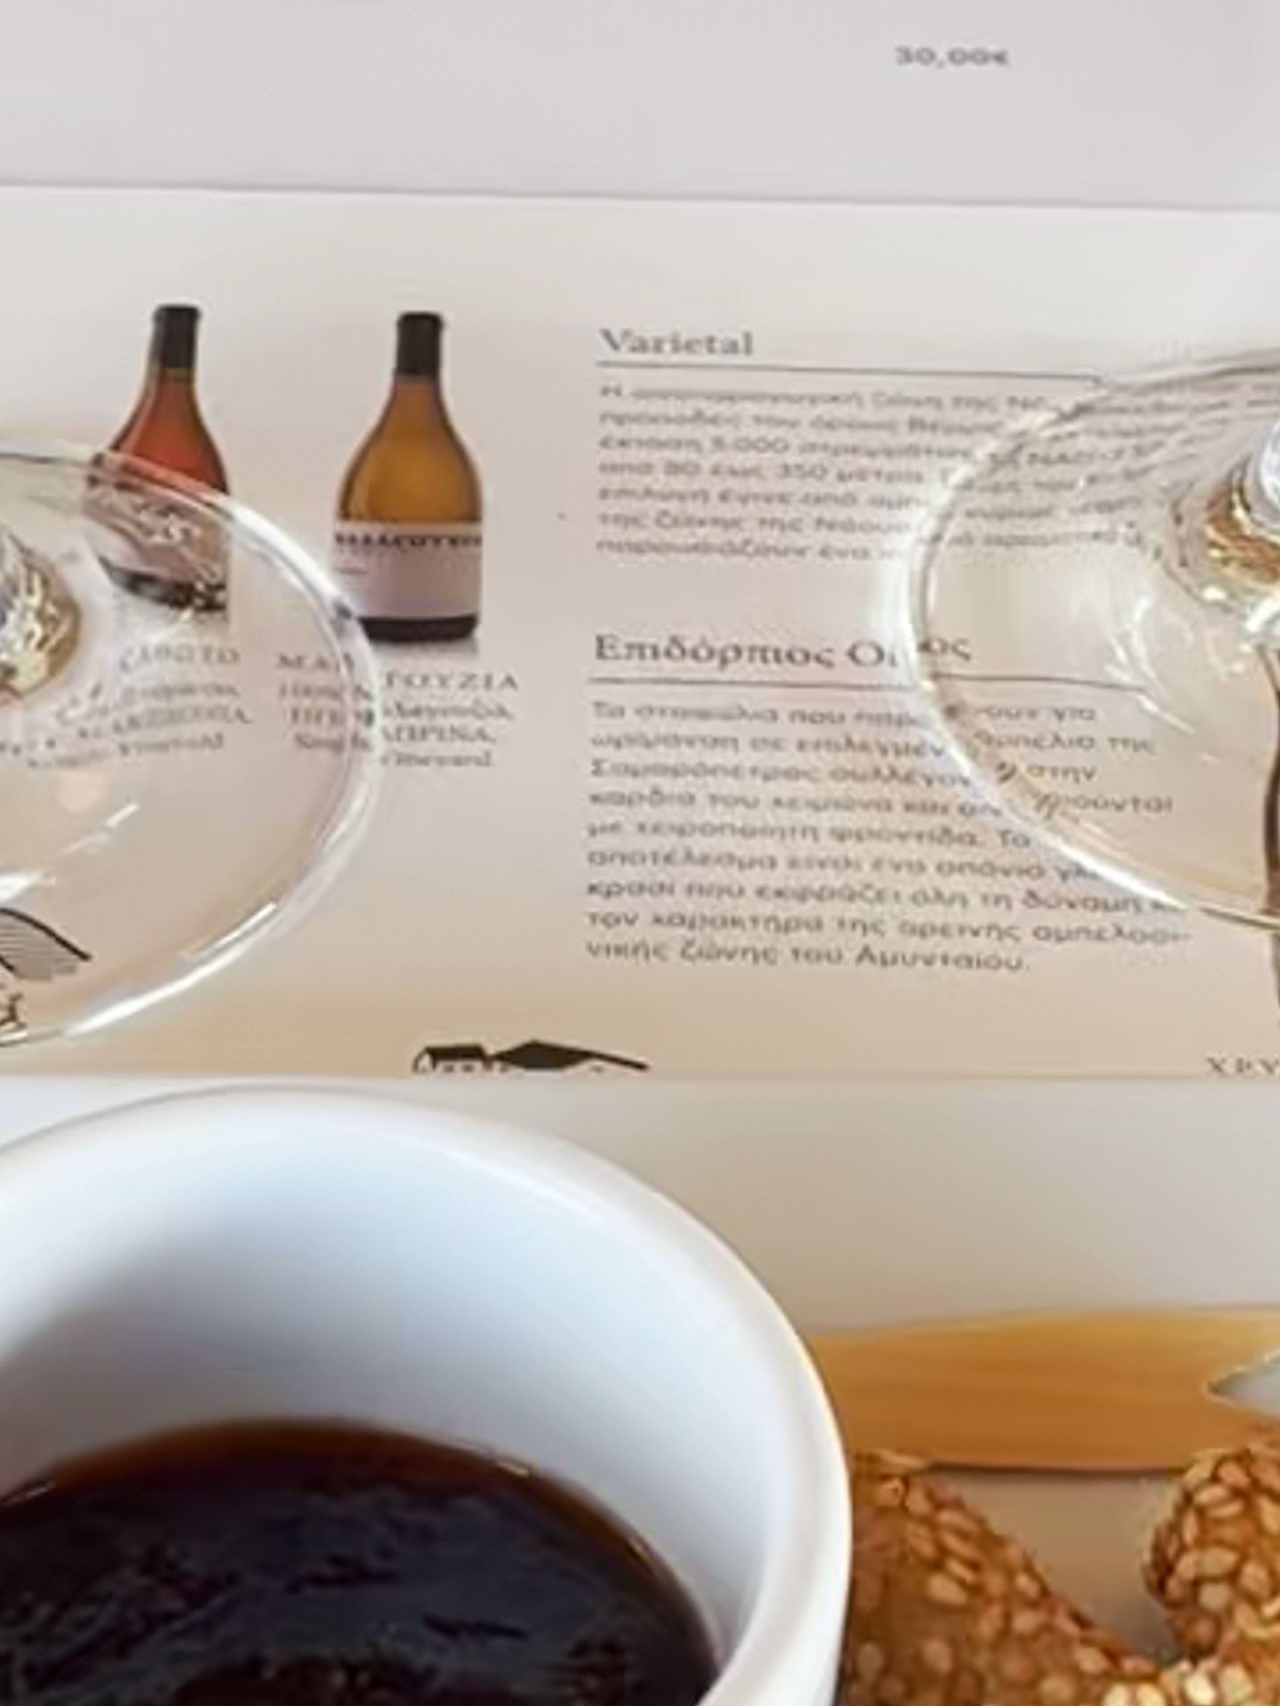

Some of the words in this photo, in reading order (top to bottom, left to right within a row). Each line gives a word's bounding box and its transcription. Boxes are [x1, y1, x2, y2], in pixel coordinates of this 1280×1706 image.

[600, 329, 753, 355] Varietal
[594, 634, 834, 676] Επιδόρπιος
[796, 734, 946, 757] επιλεγμέν
